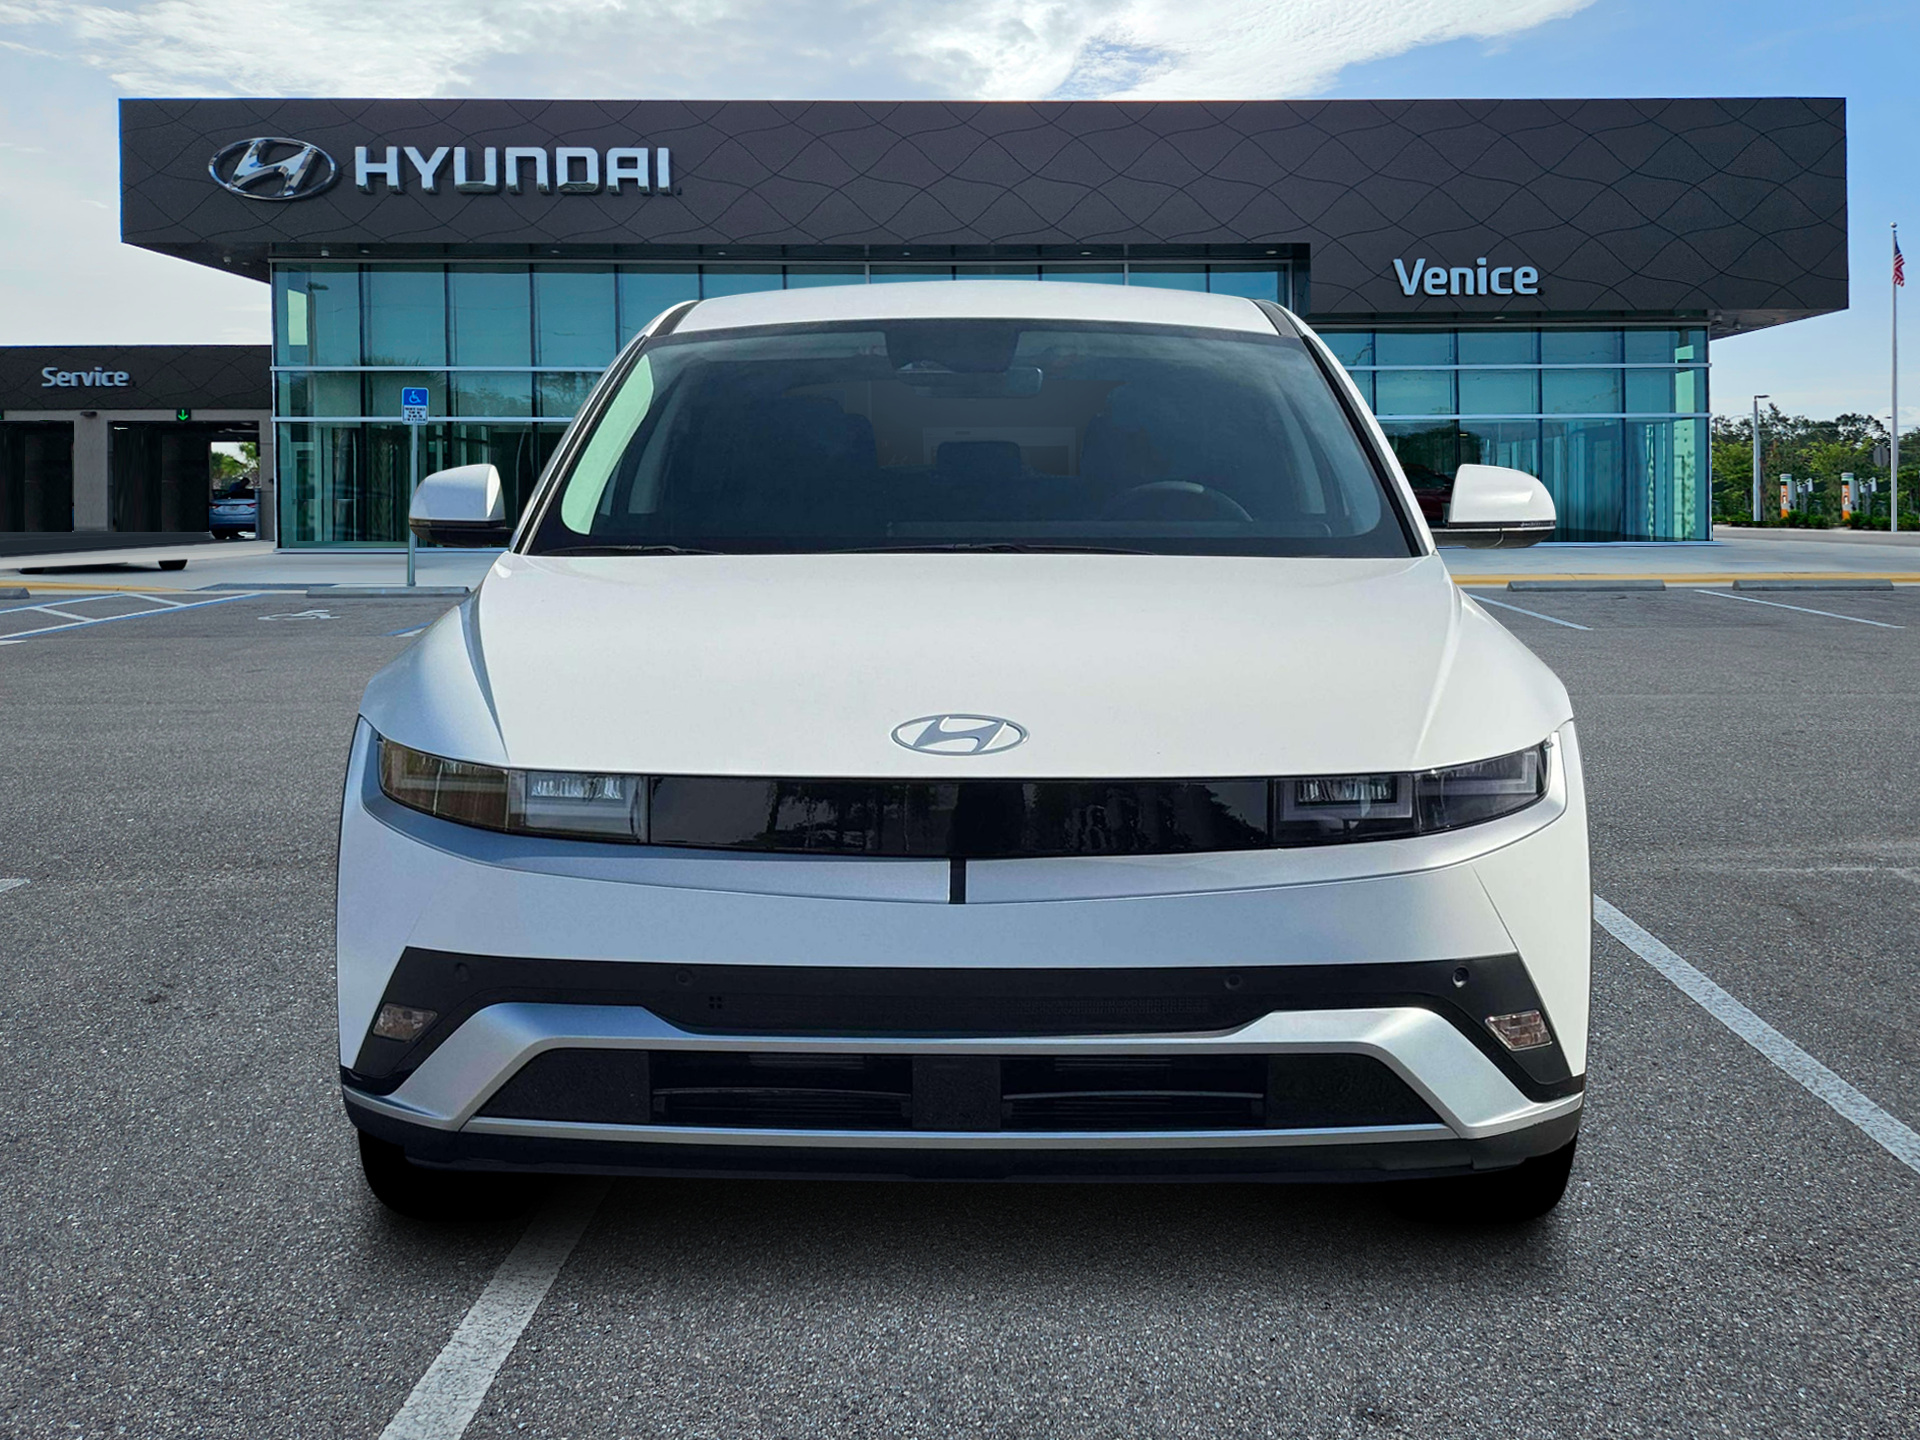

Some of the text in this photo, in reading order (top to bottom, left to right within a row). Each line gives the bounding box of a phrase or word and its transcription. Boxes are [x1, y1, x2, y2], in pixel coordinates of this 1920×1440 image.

[354, 146, 672, 193] HYUNDAI
[1392, 257, 1539, 296] Venice
[41, 366, 130, 388] Service
